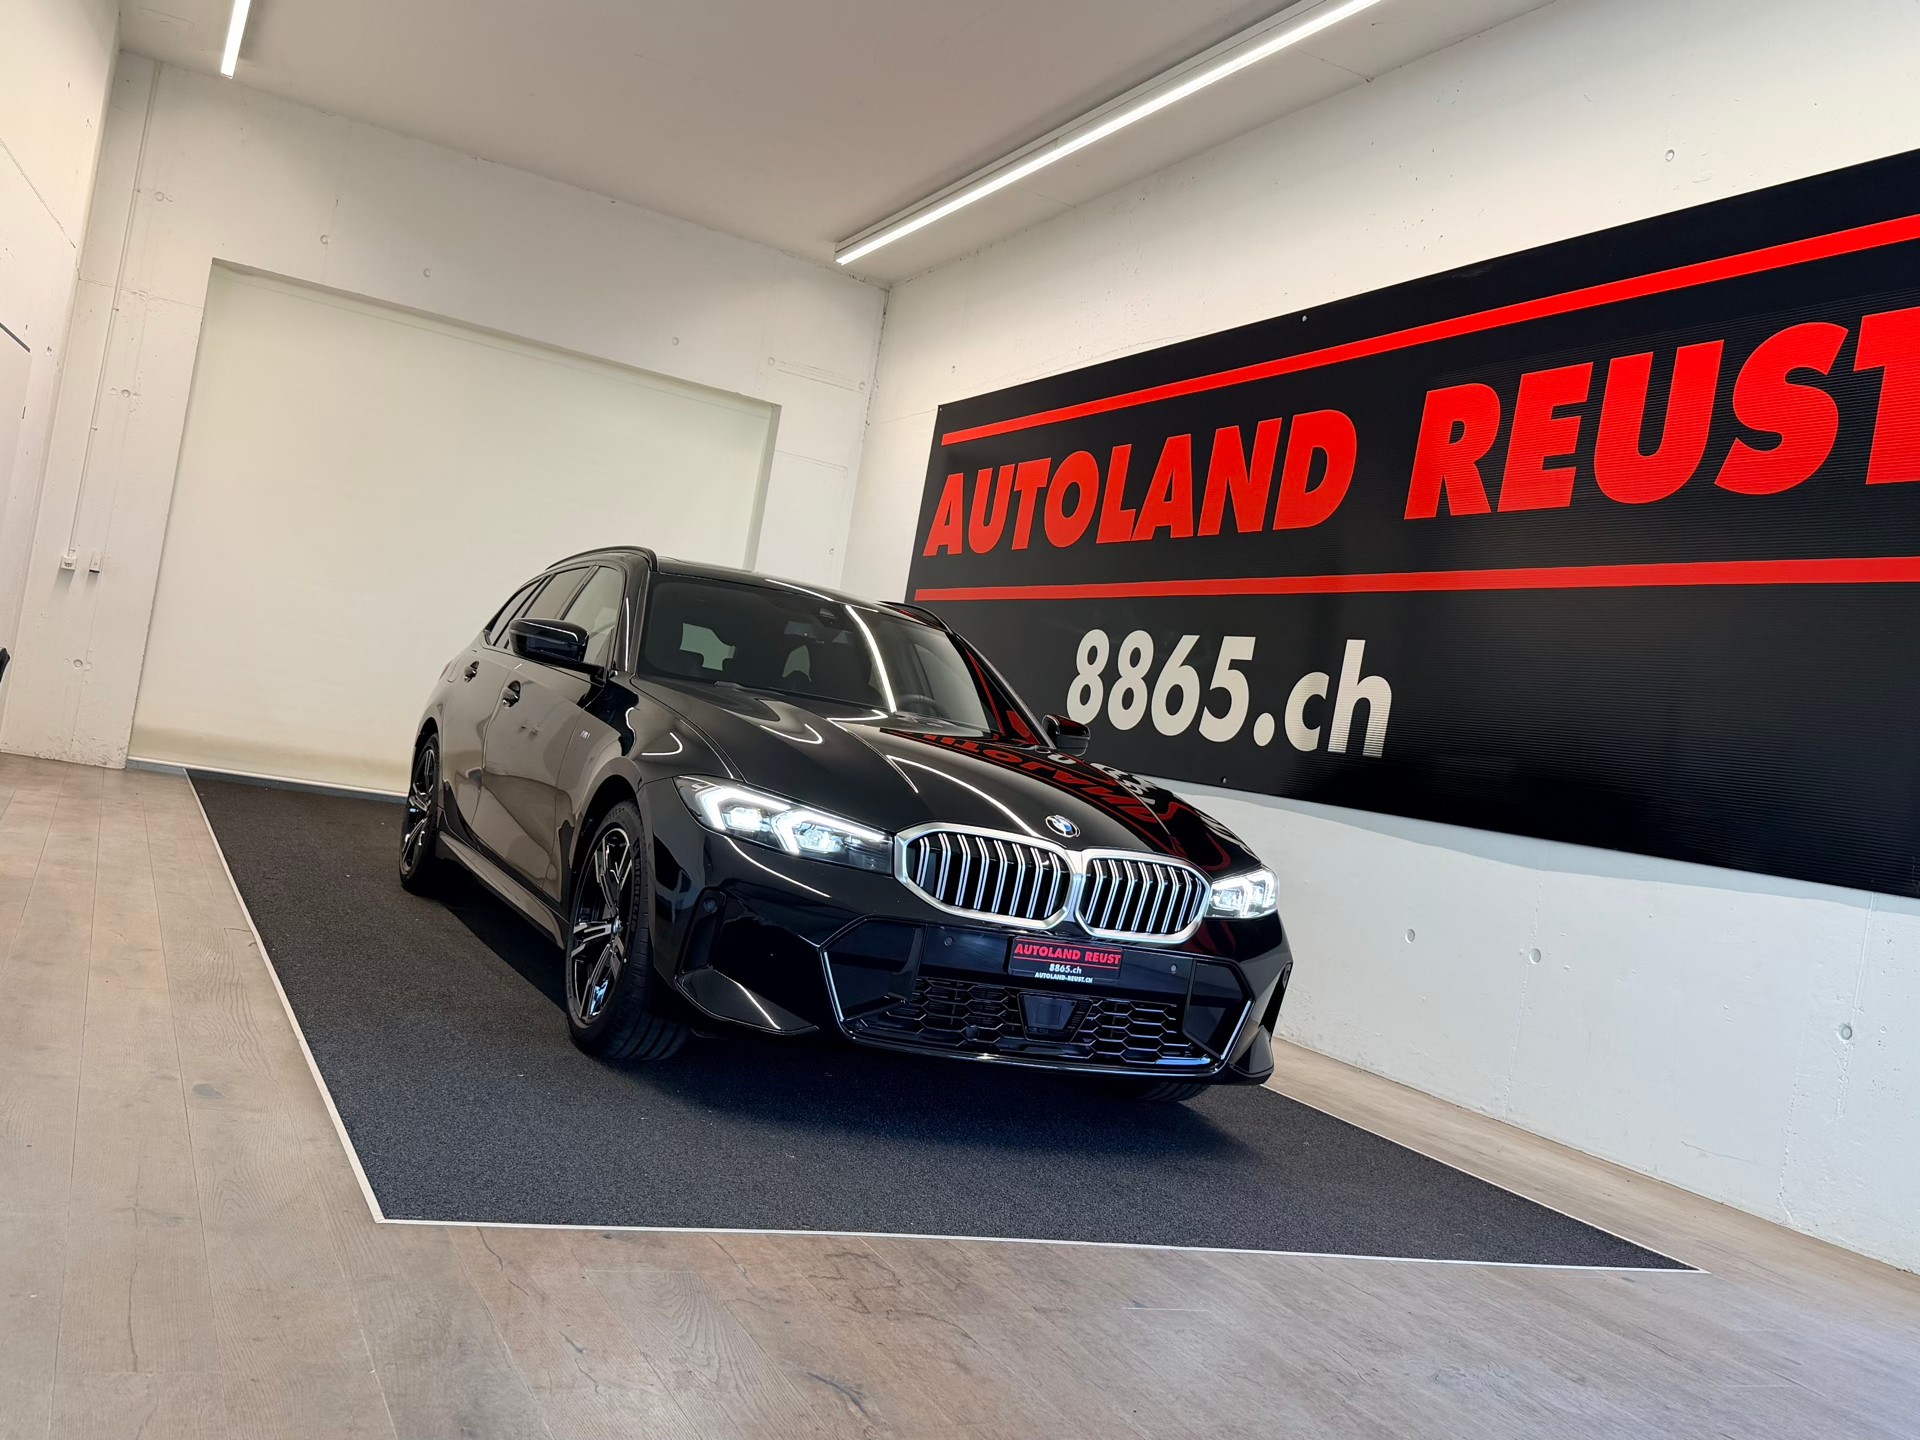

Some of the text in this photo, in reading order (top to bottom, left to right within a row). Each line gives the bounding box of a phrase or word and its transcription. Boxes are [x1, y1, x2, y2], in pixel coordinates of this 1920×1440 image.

[922, 306, 1920, 557] AUTOLAND REUST
[1066, 628, 1392, 758] 8865.ch
[630, 858, 643, 933] MICHELIN
[1014, 943, 1121, 964] AUTOLAND REUST
[1049, 963, 1082, 974] 8865.ch
